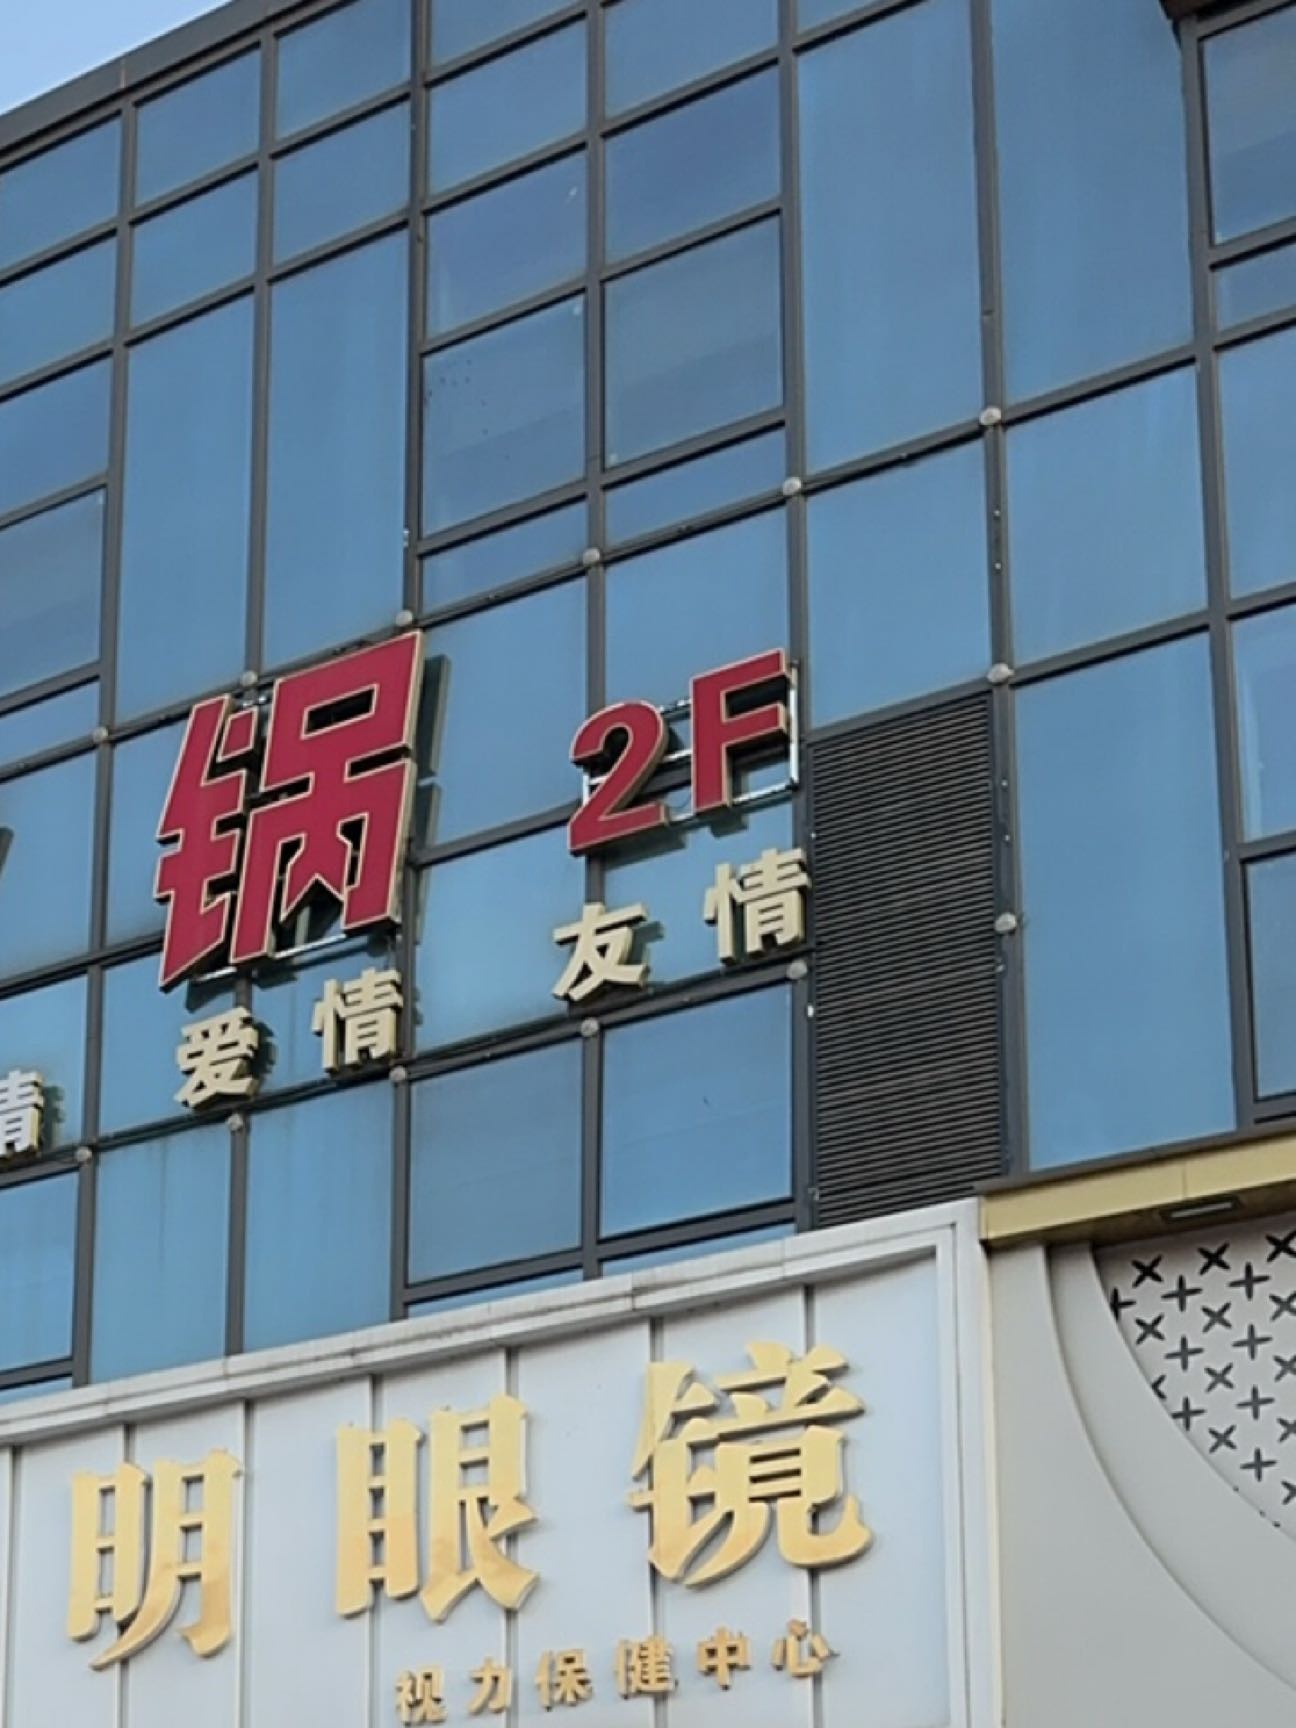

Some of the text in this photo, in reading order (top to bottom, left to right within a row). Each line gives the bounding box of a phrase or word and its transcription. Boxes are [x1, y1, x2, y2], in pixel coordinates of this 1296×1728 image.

[567, 648, 801, 856] 2F
[174, 966, 406, 1110] 爱情
[553, 846, 812, 1004] 友情
[394, 1618, 838, 1728] 视力保健中心
